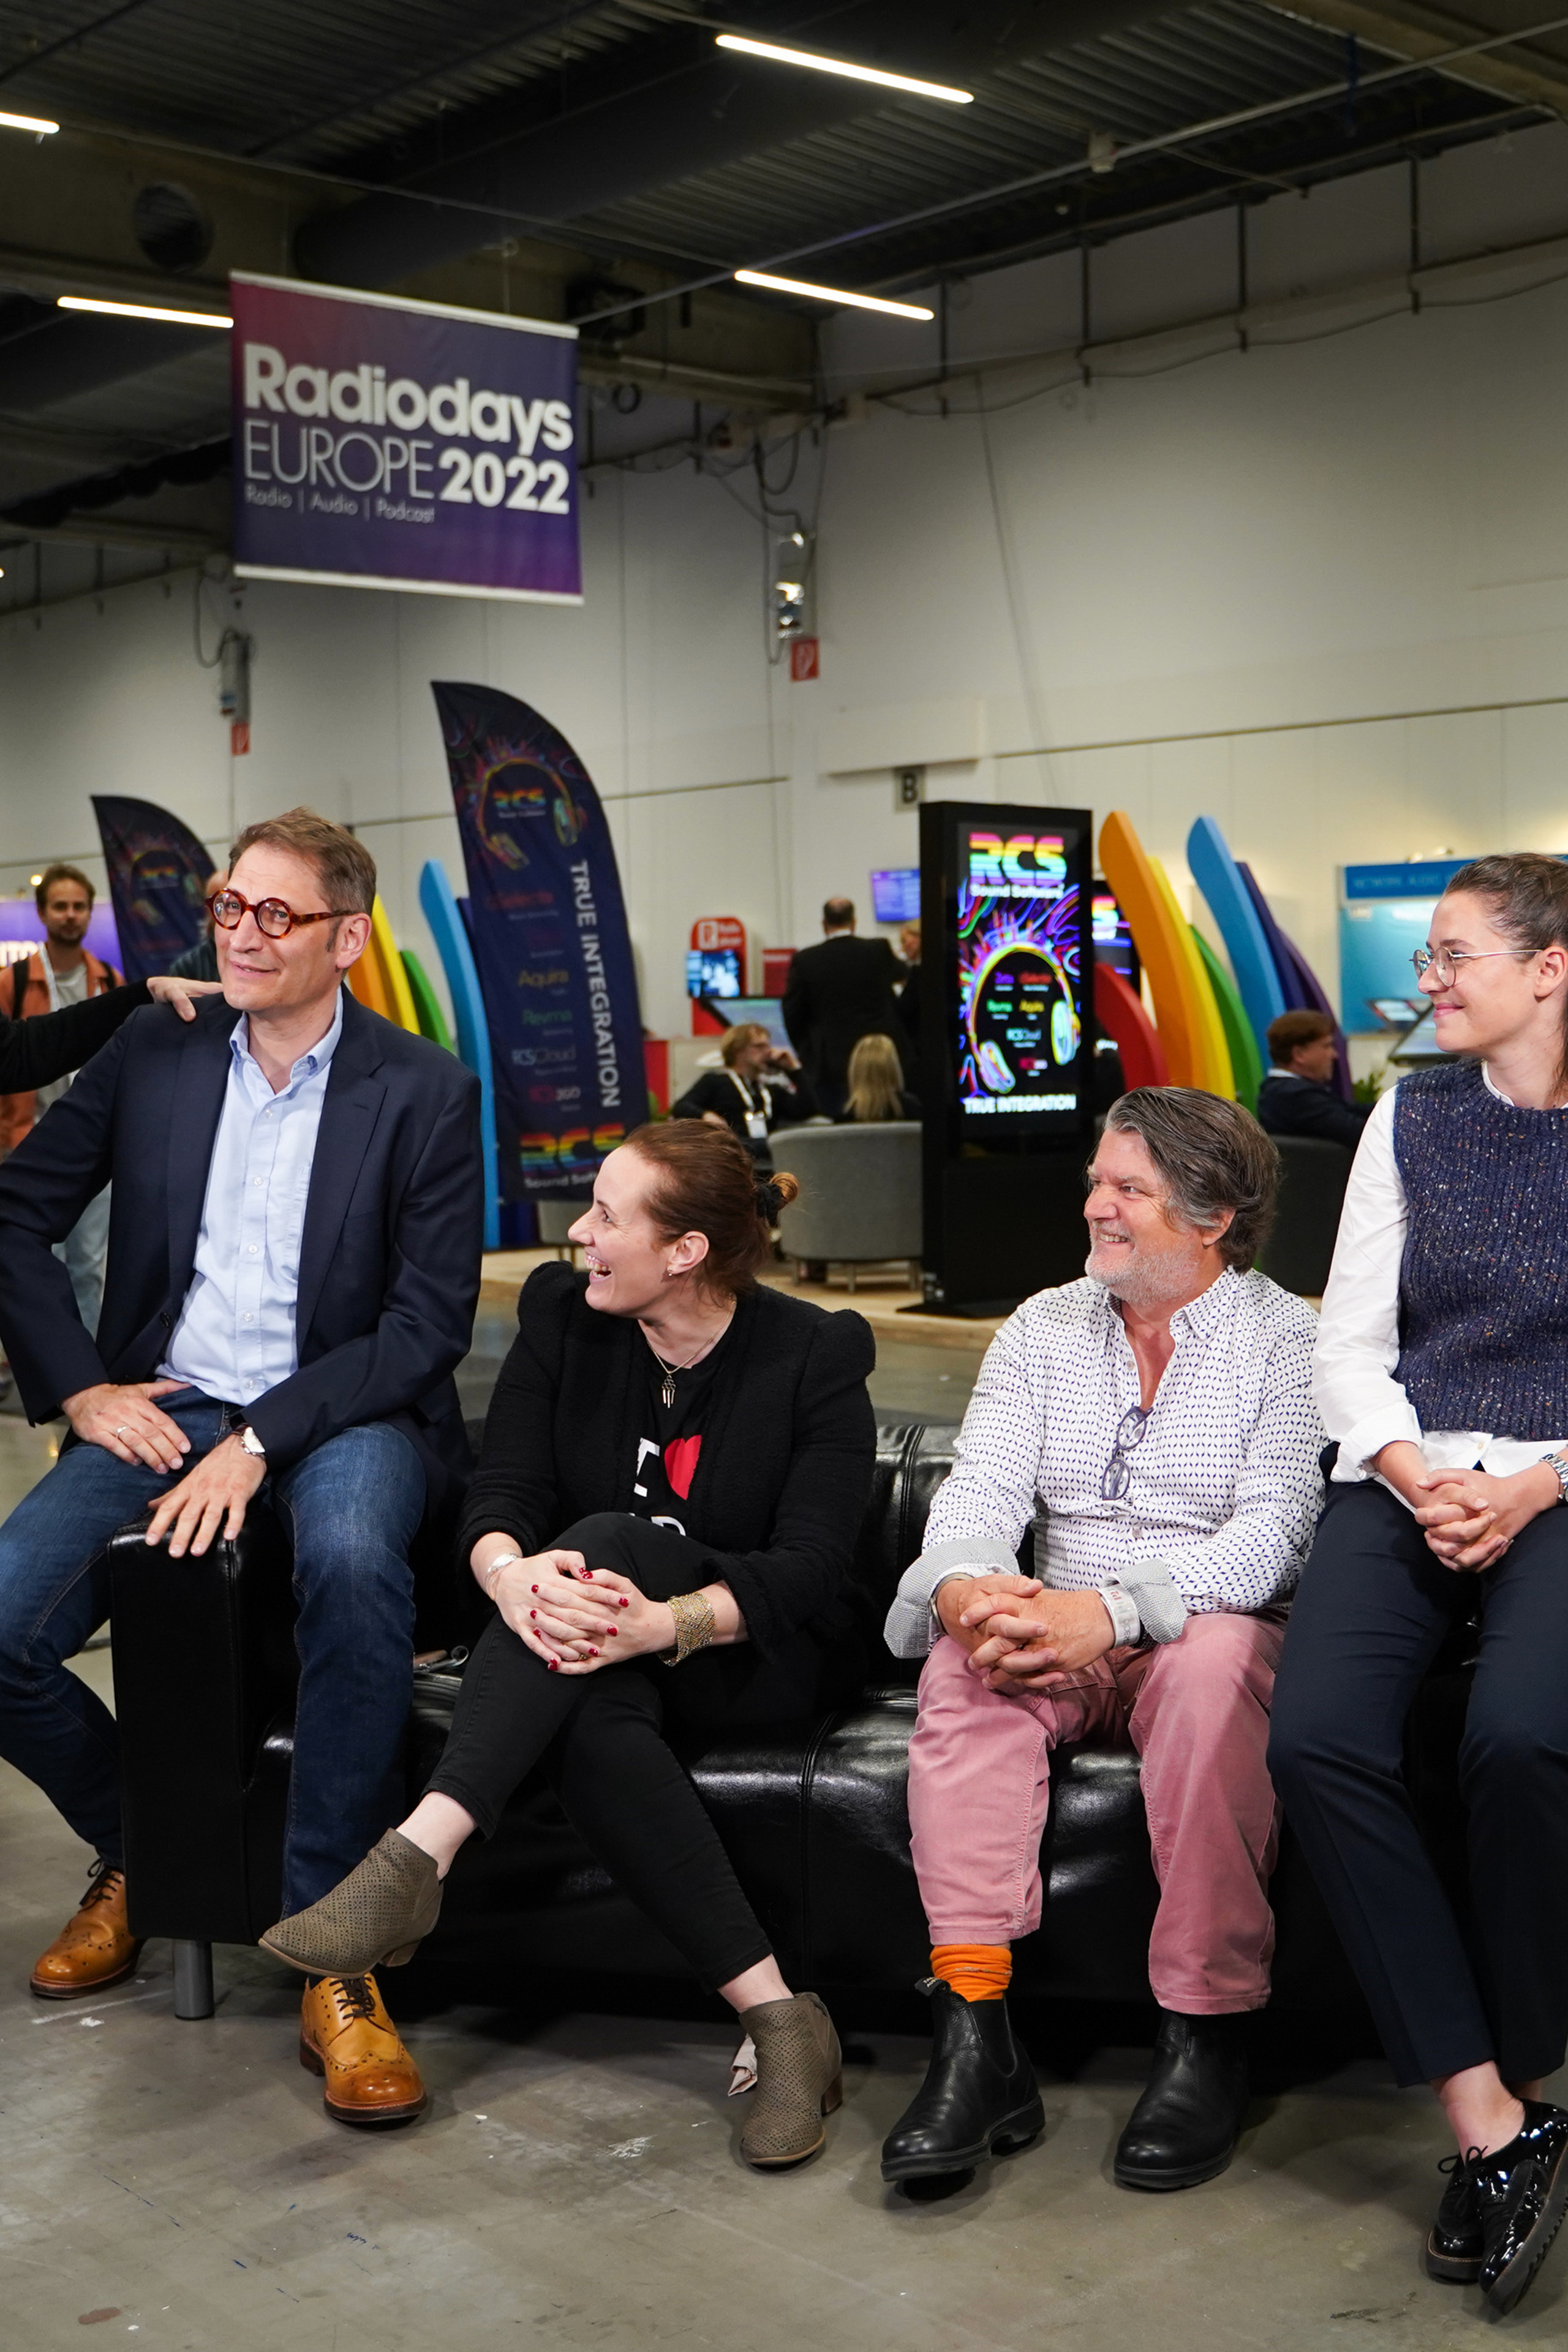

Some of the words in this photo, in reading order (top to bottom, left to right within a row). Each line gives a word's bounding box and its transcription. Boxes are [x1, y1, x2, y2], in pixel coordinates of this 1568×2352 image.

[244, 342, 574, 456] Radiodays
[246, 420, 434, 499] EUROPE
[439, 448, 569, 514] 2022
[245, 483, 293, 508] Radio
[310, 492, 358, 516] Audio
[375, 497, 435, 523] Podcast
[570, 859, 597, 927] TRUE
[969, 832, 1067, 886] RCS
[581, 933, 621, 1107] INTEGRATION
[964, 1096, 997, 1114] TRUE
